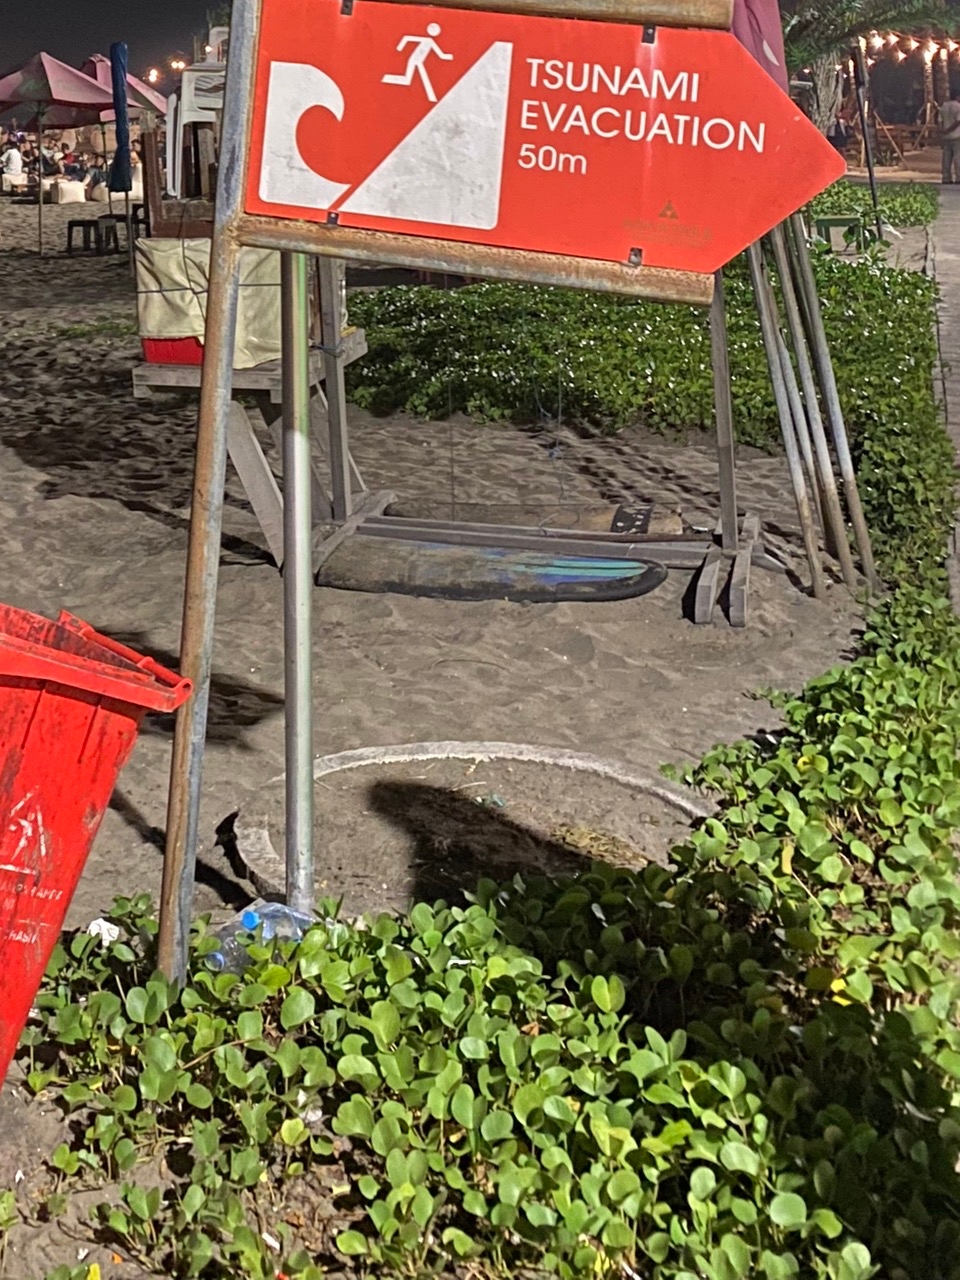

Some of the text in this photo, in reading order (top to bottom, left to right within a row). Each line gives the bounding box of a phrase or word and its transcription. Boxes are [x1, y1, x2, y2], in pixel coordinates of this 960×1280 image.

[526, 57, 700, 103] TSUNAMI
[520, 99, 766, 153] EVACUATION
[517, 143, 587, 175] 50m
